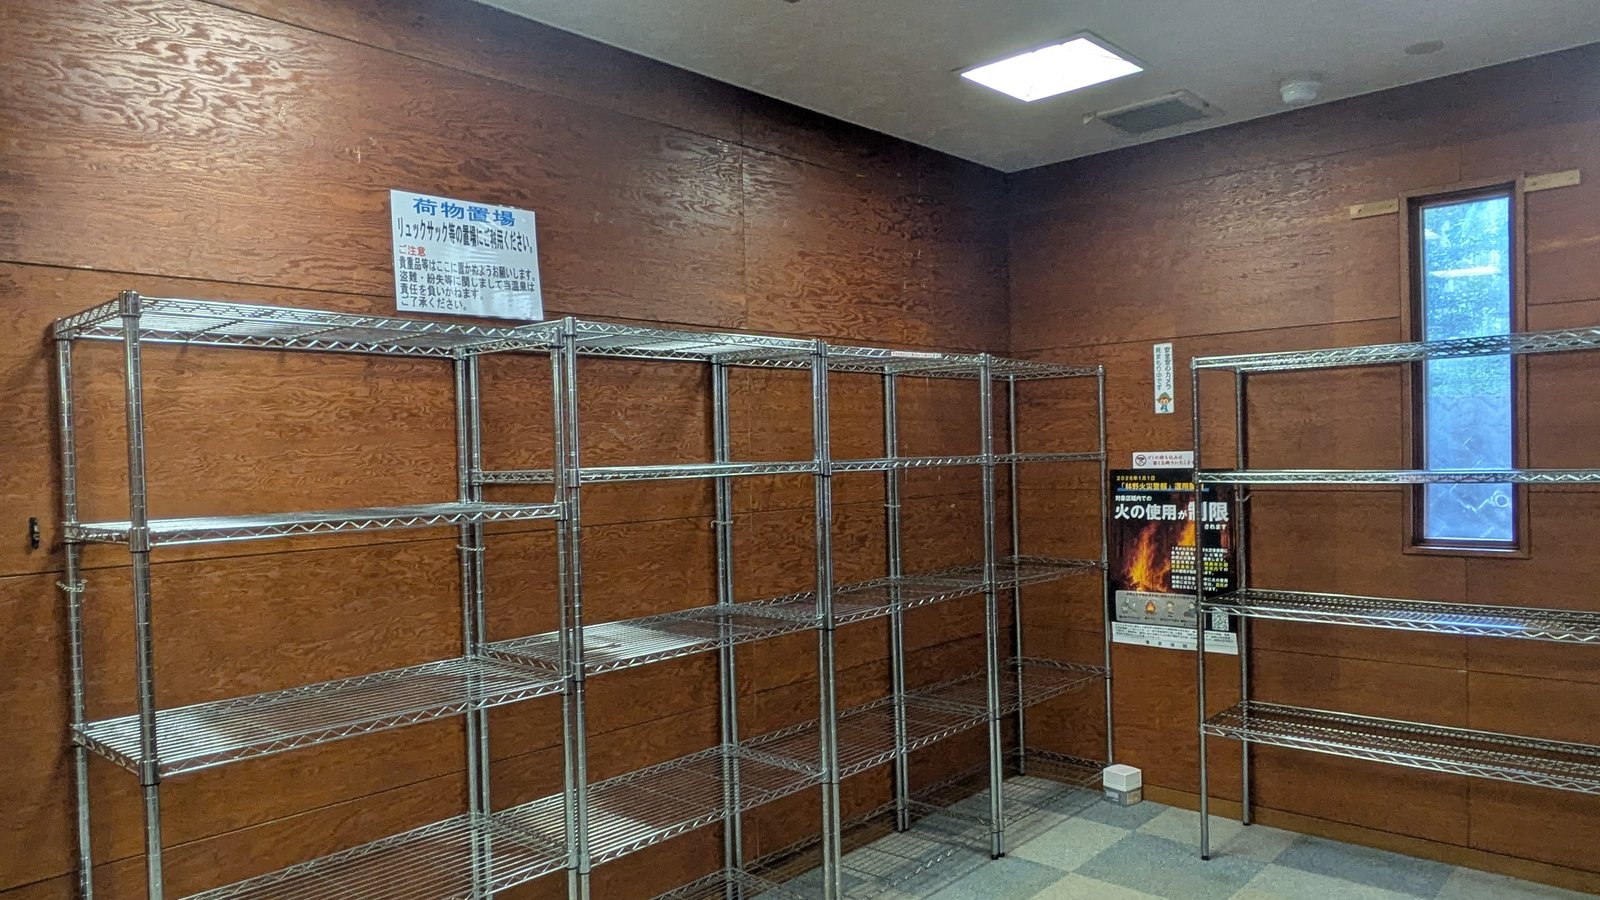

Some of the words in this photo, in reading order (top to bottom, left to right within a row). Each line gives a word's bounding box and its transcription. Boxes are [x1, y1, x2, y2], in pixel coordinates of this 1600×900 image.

[413, 197, 515, 227] 荷物置場
[397, 217, 533, 254] リュックサック等の置場にご利用ください。
[399, 244, 426, 257] ご注意
[400, 271, 535, 292] 盗難・紛失等に関しまして当温泉は
[400, 284, 483, 300] 責任を負いかねます。
[400, 295, 467, 311] ご了承ください。
